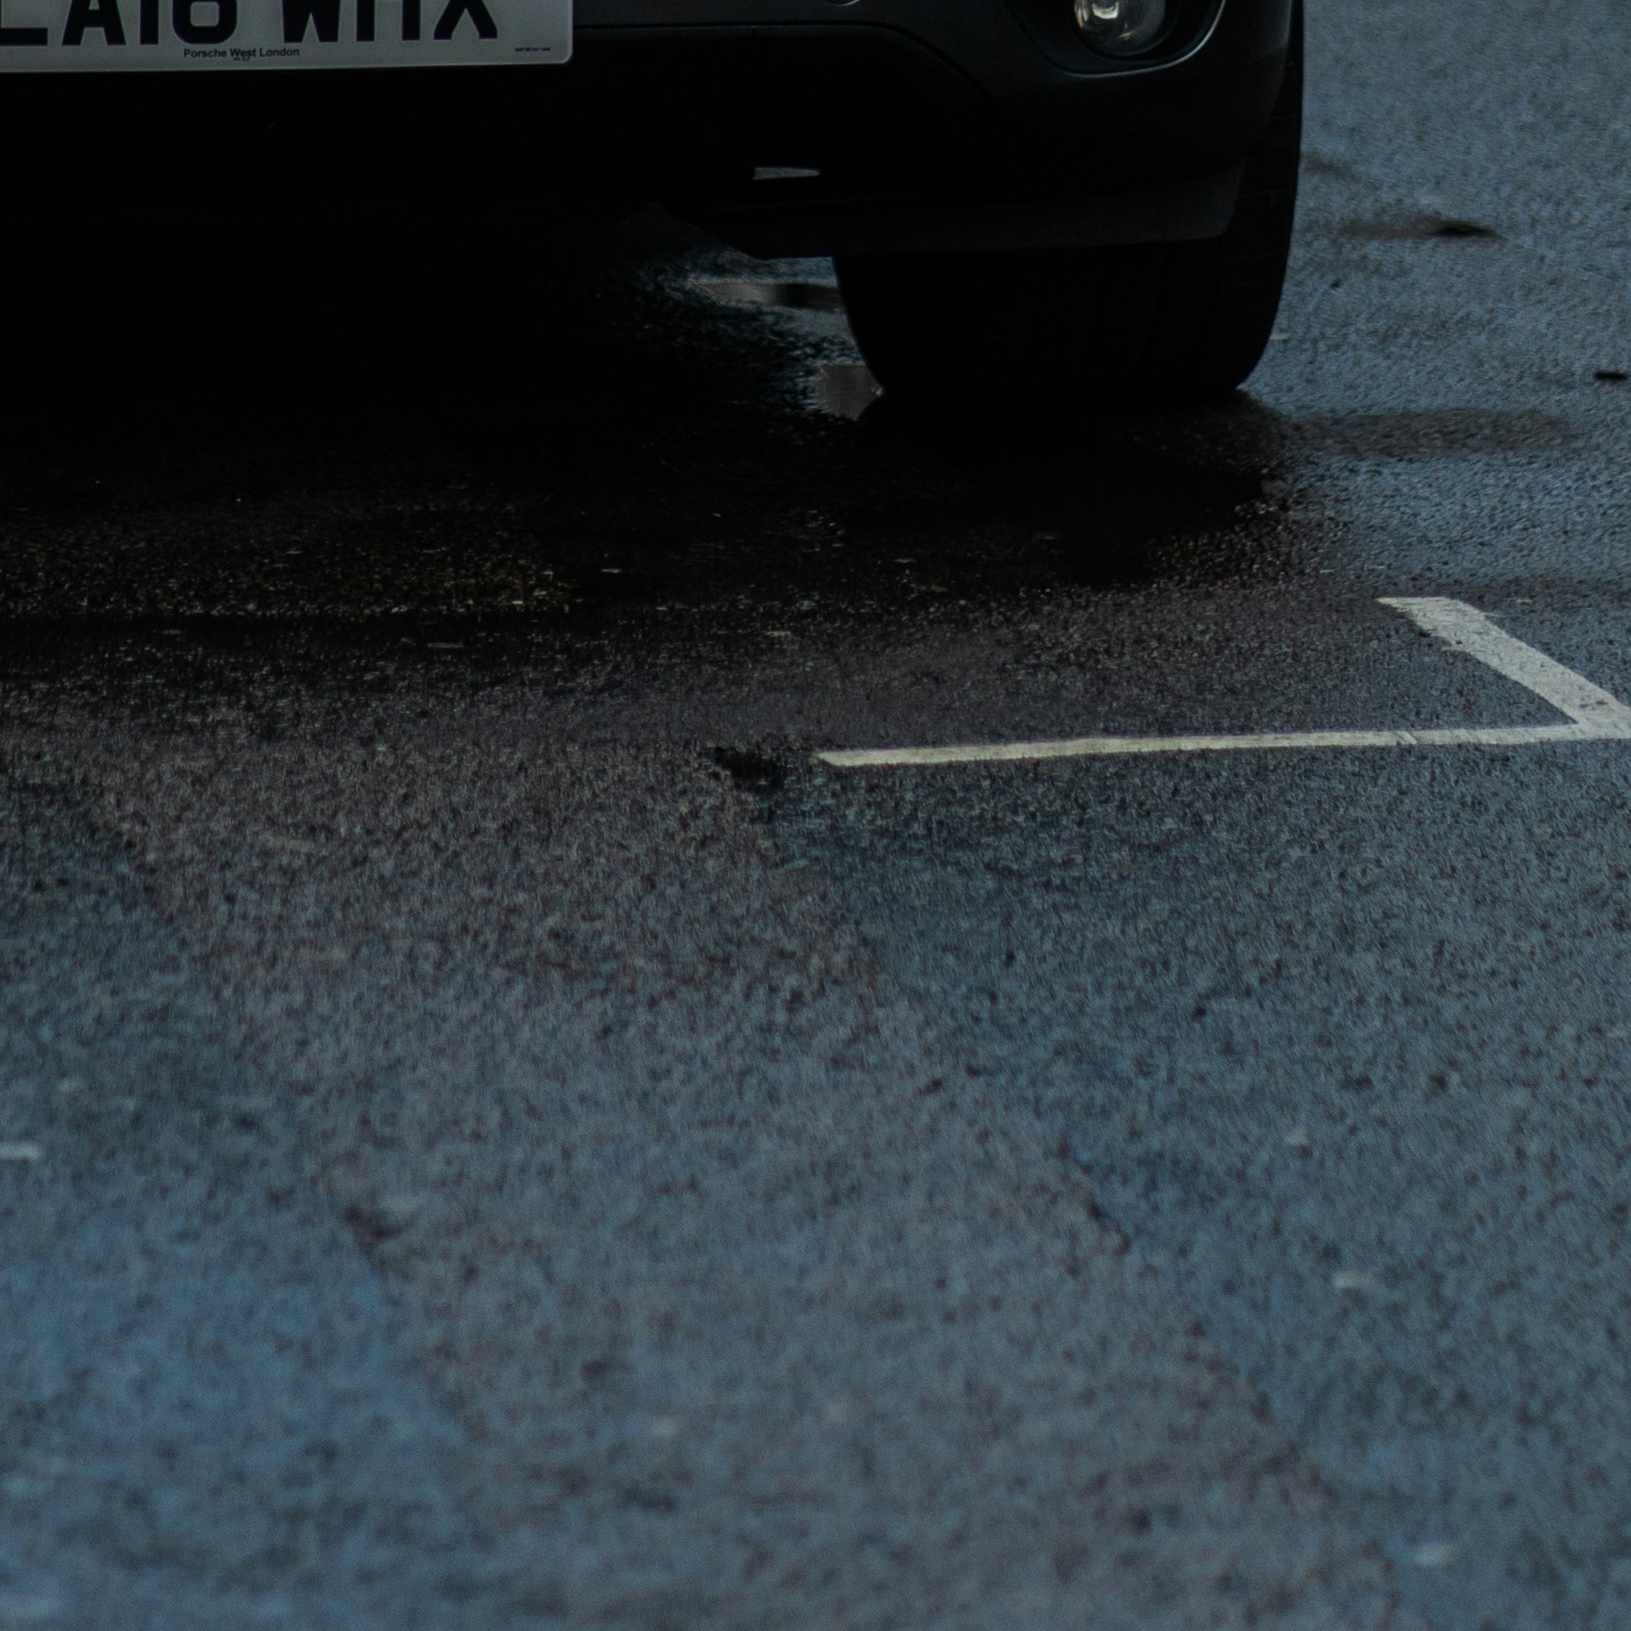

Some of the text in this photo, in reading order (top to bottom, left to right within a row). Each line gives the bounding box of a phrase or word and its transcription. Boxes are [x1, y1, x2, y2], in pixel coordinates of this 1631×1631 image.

[183, 47, 300, 58] Porsche West London
